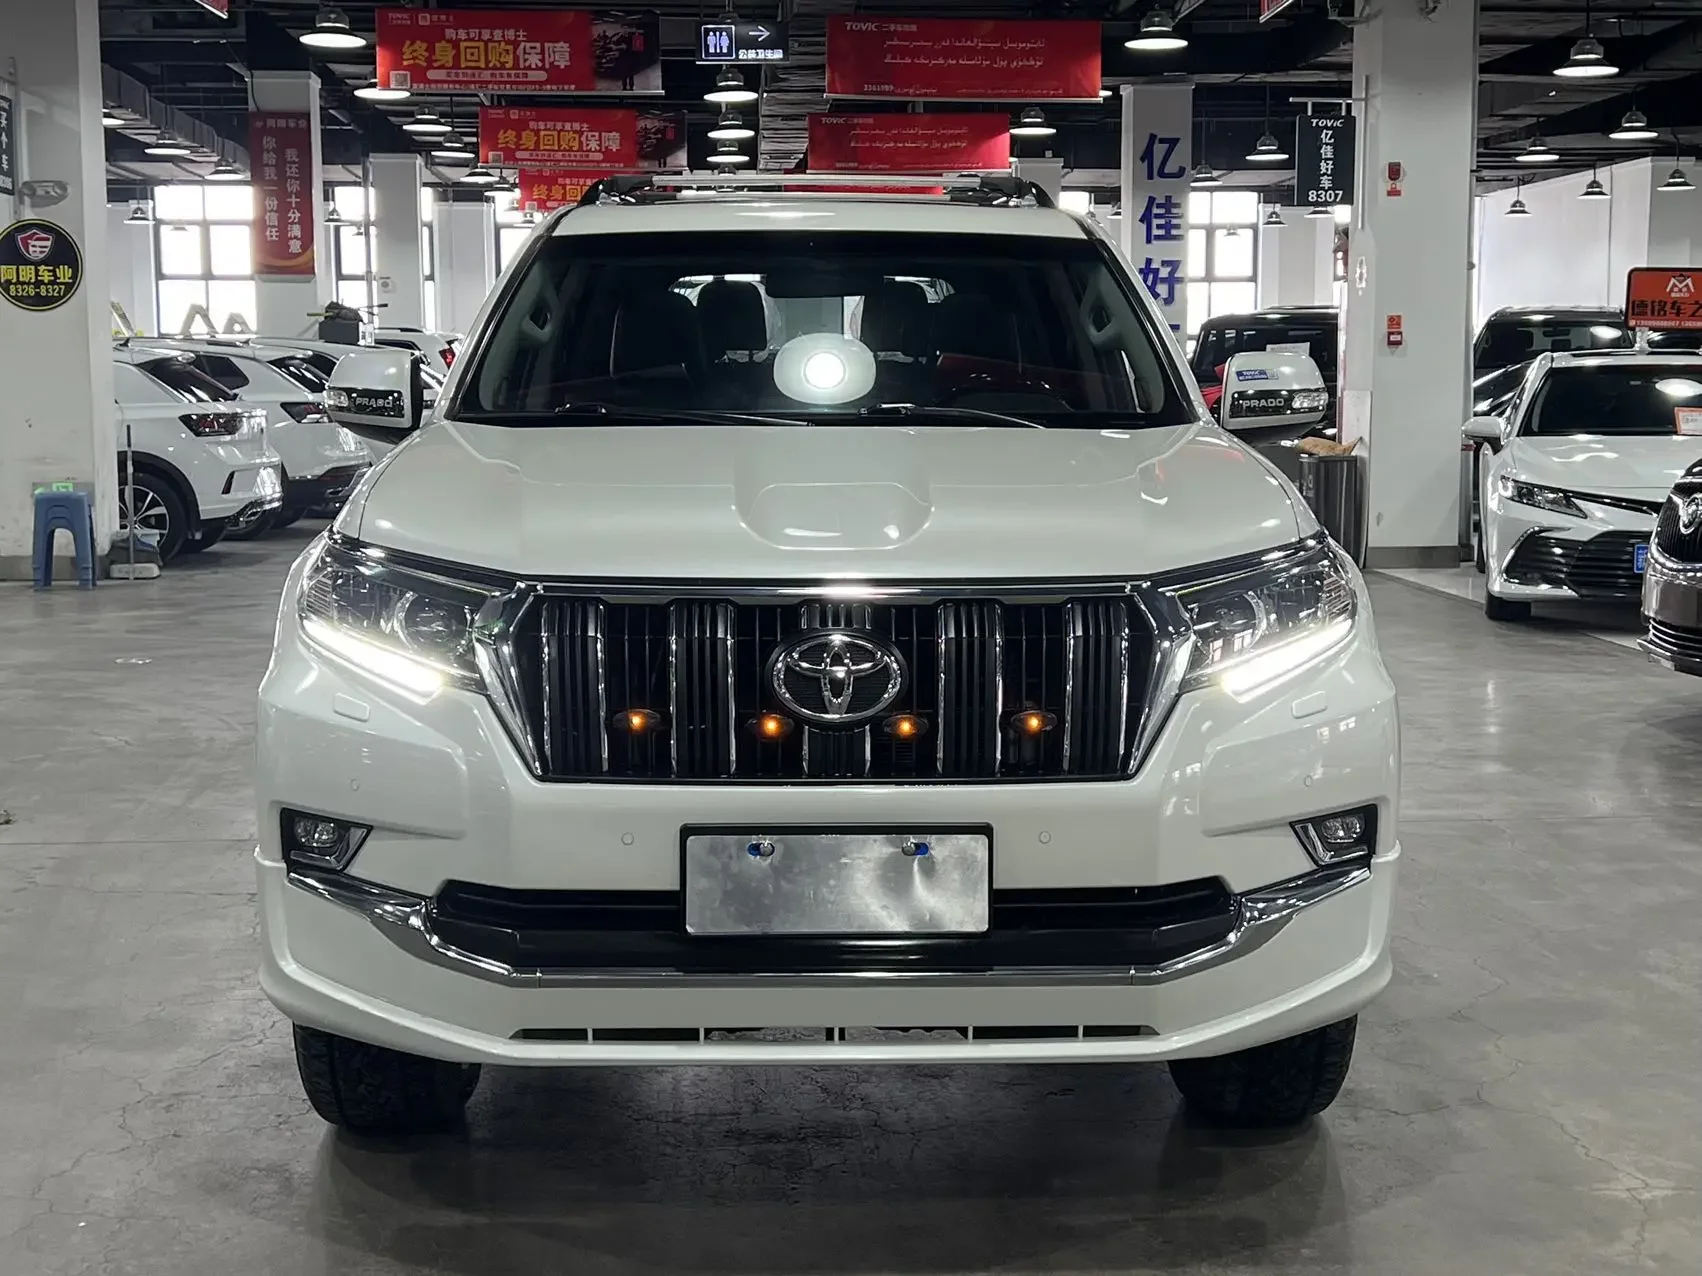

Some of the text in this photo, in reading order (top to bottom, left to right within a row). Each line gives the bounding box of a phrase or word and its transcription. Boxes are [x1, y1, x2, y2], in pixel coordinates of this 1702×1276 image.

[844, 21, 881, 31] TOVIC
[444, 28, 528, 41] 购车可享查博士
[401, 41, 572, 70] 终身回购保障
[738, 49, 784, 59] 公共卫生间
[1310, 119, 1345, 127] TOVIC
[497, 129, 621, 151] 终身回购保障
[1320, 129, 1335, 190] 亿佳好车
[262, 136, 279, 241] 你给我一份信任
[1308, 190, 1344, 202] 8307
[285, 148, 302, 253] 我还你十分满意
[1138, 132, 1187, 332] 亿佳好
[0, 265, 73, 283] 阿明车业
[9, 285, 66, 297] 8326-8327
[1242, 399, 1284, 408] PRADO
